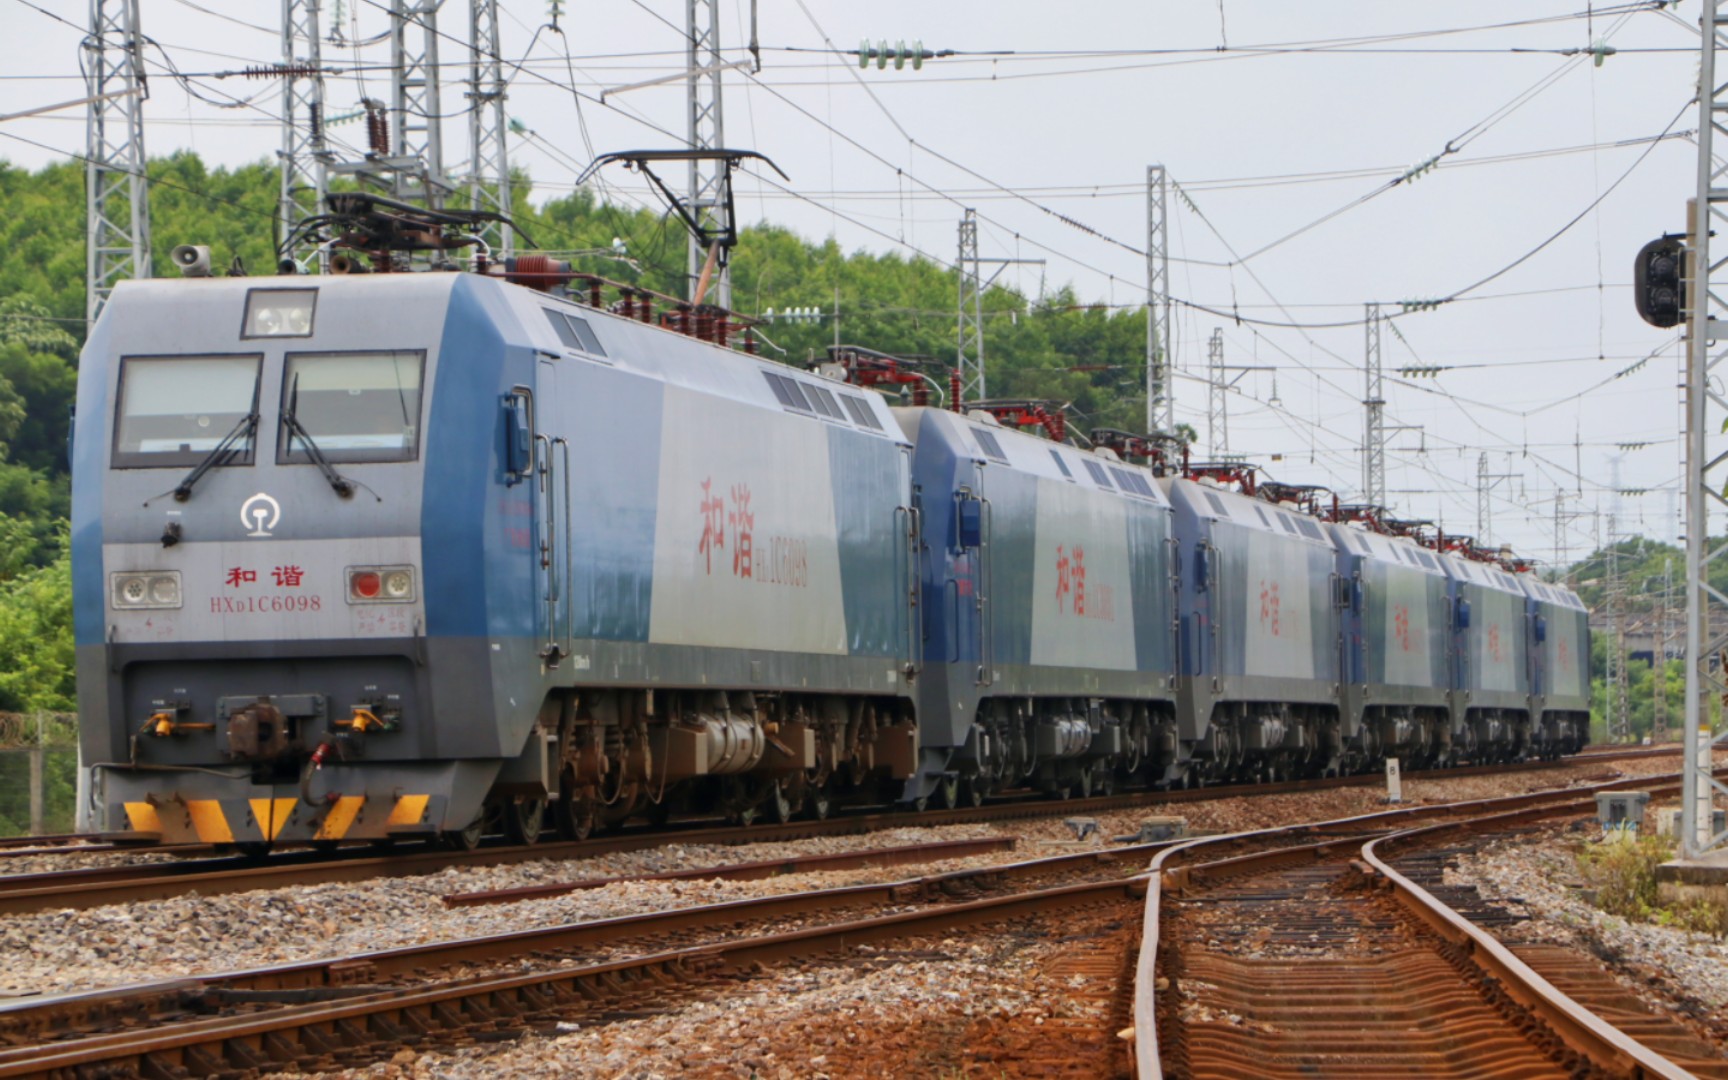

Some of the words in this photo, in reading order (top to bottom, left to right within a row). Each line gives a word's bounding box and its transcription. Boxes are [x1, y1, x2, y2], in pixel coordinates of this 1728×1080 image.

[698, 476, 754, 579] 和谐
[225, 566, 304, 588] 和谐
[1056, 544, 1085, 616] 和谐
[210, 595, 321, 613] HXD1C6098
